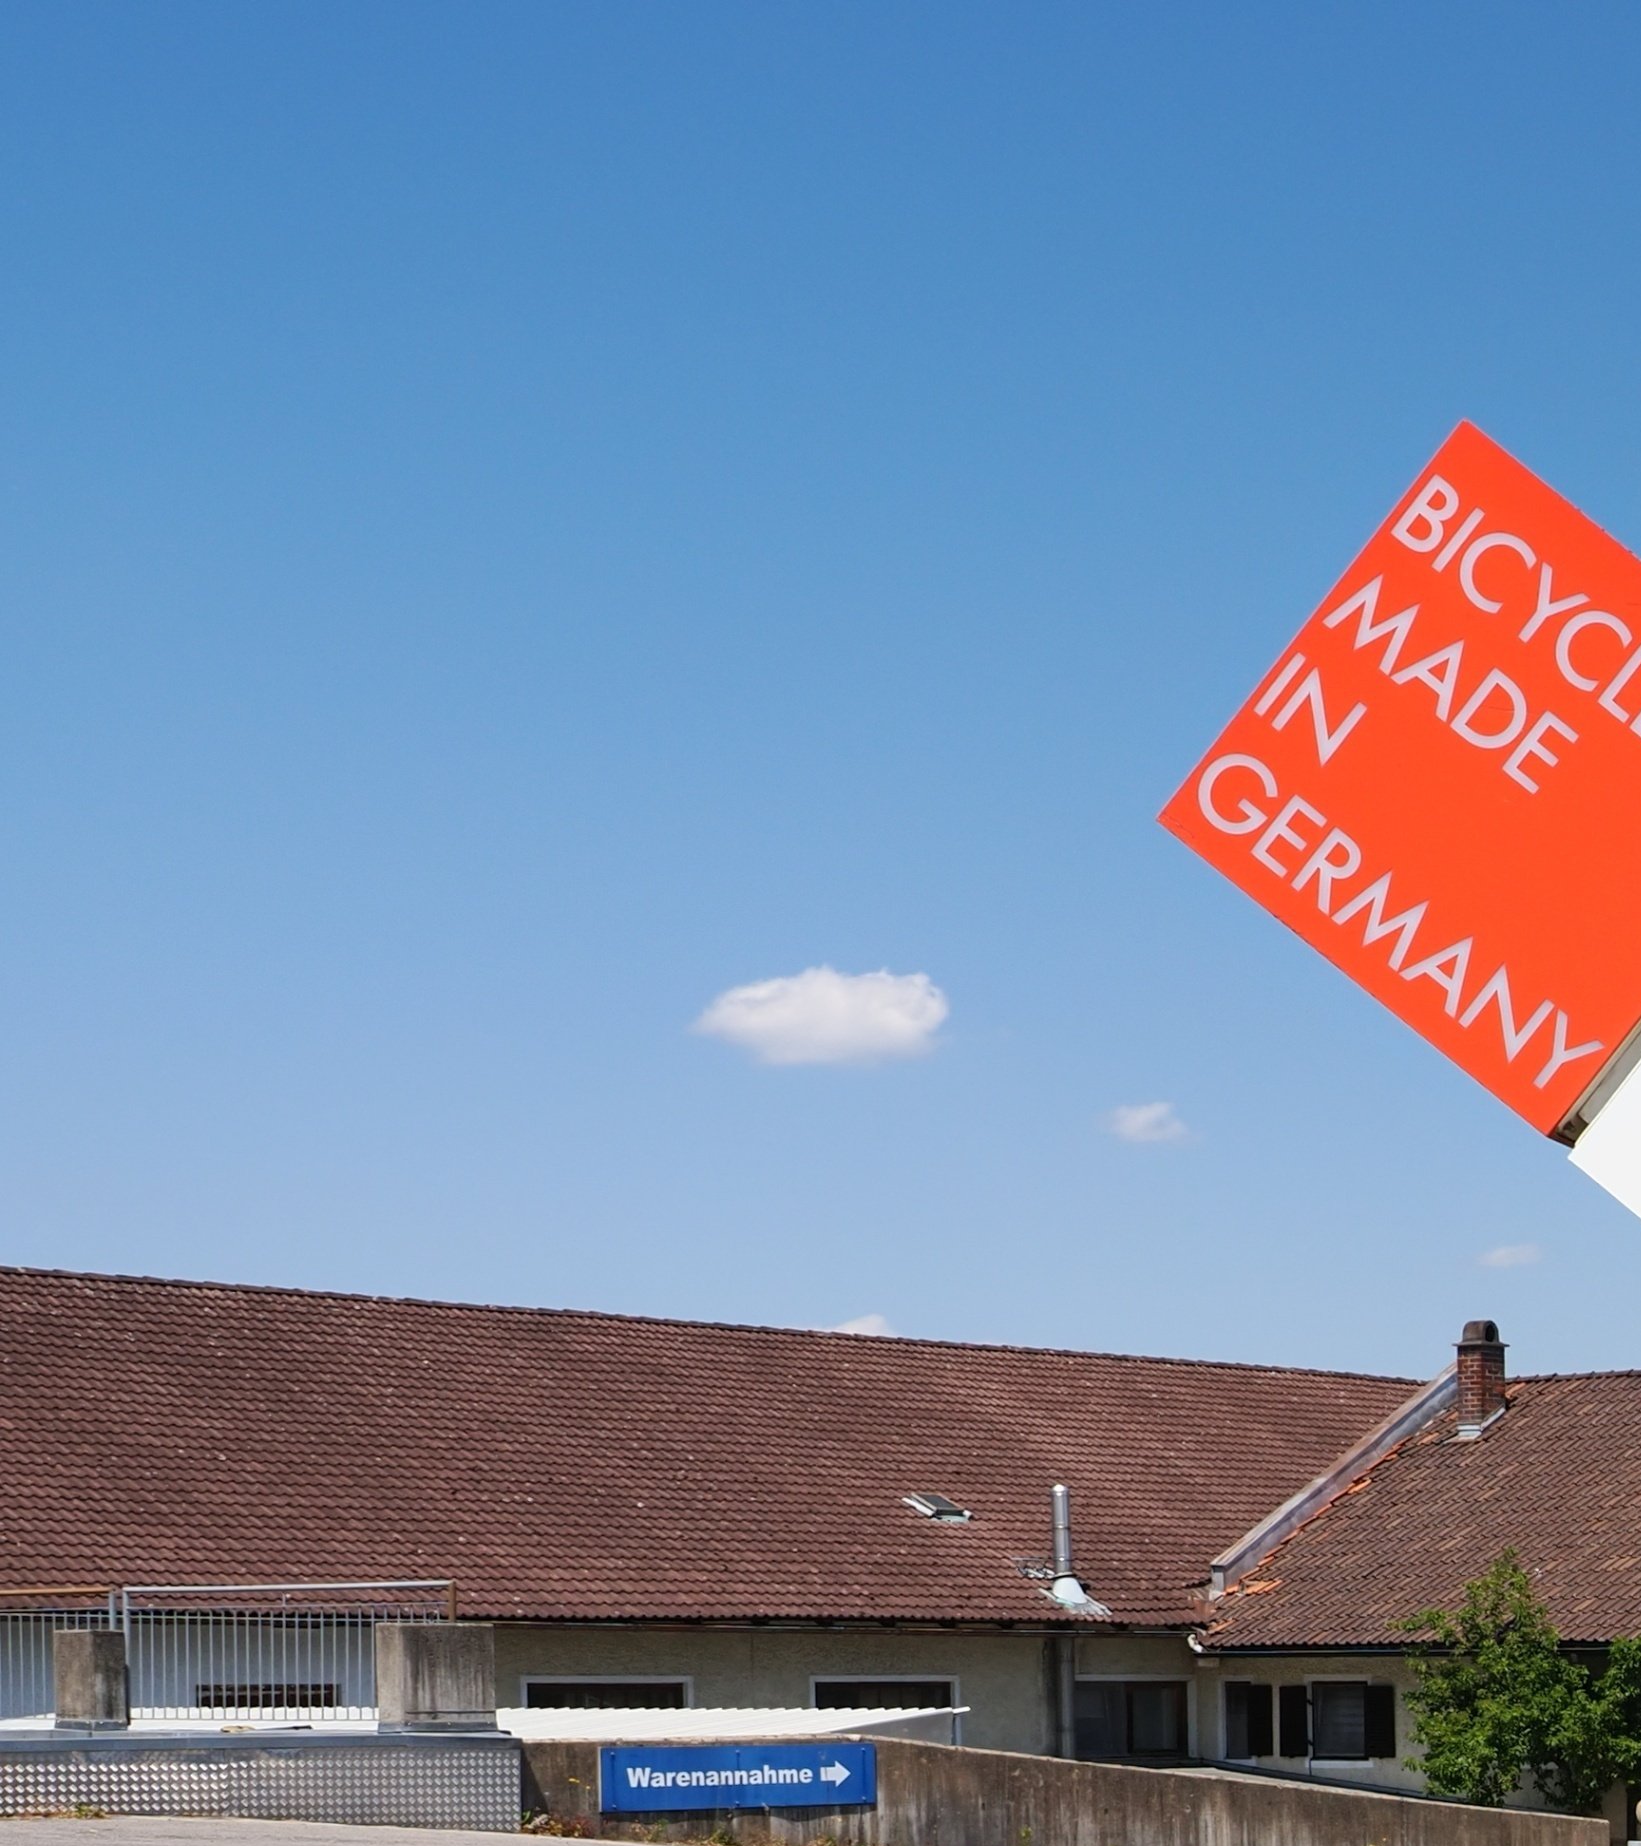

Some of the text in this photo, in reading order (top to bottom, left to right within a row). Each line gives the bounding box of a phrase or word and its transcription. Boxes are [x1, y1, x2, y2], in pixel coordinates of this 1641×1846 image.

[1253, 652, 1368, 768] IN
[1323, 572, 1580, 795] MADE
[1197, 752, 1605, 1090] GERMANY
[626, 1764, 813, 1789] Warenannahme
